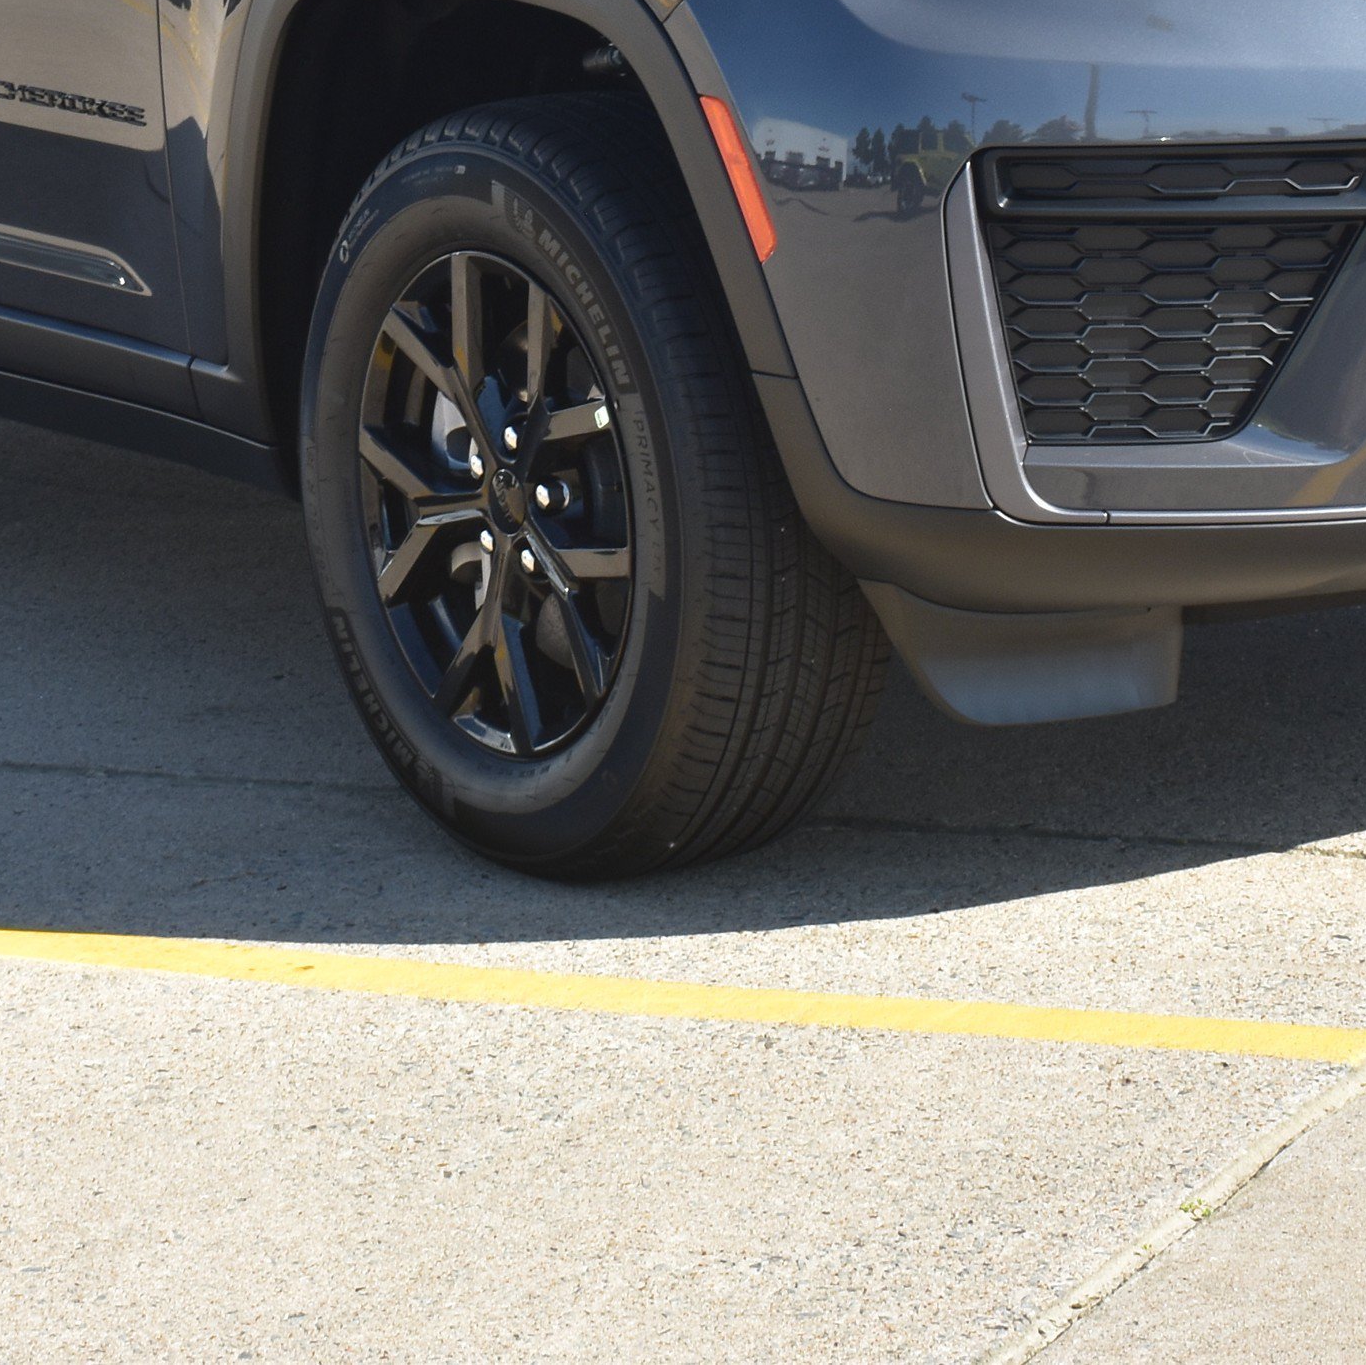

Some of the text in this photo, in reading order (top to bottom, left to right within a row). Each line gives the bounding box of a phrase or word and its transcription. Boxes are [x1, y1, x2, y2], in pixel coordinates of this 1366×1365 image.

[538, 229, 661, 531] MICHELIN PRIMACY
[333, 615, 413, 764] MICHELIN
